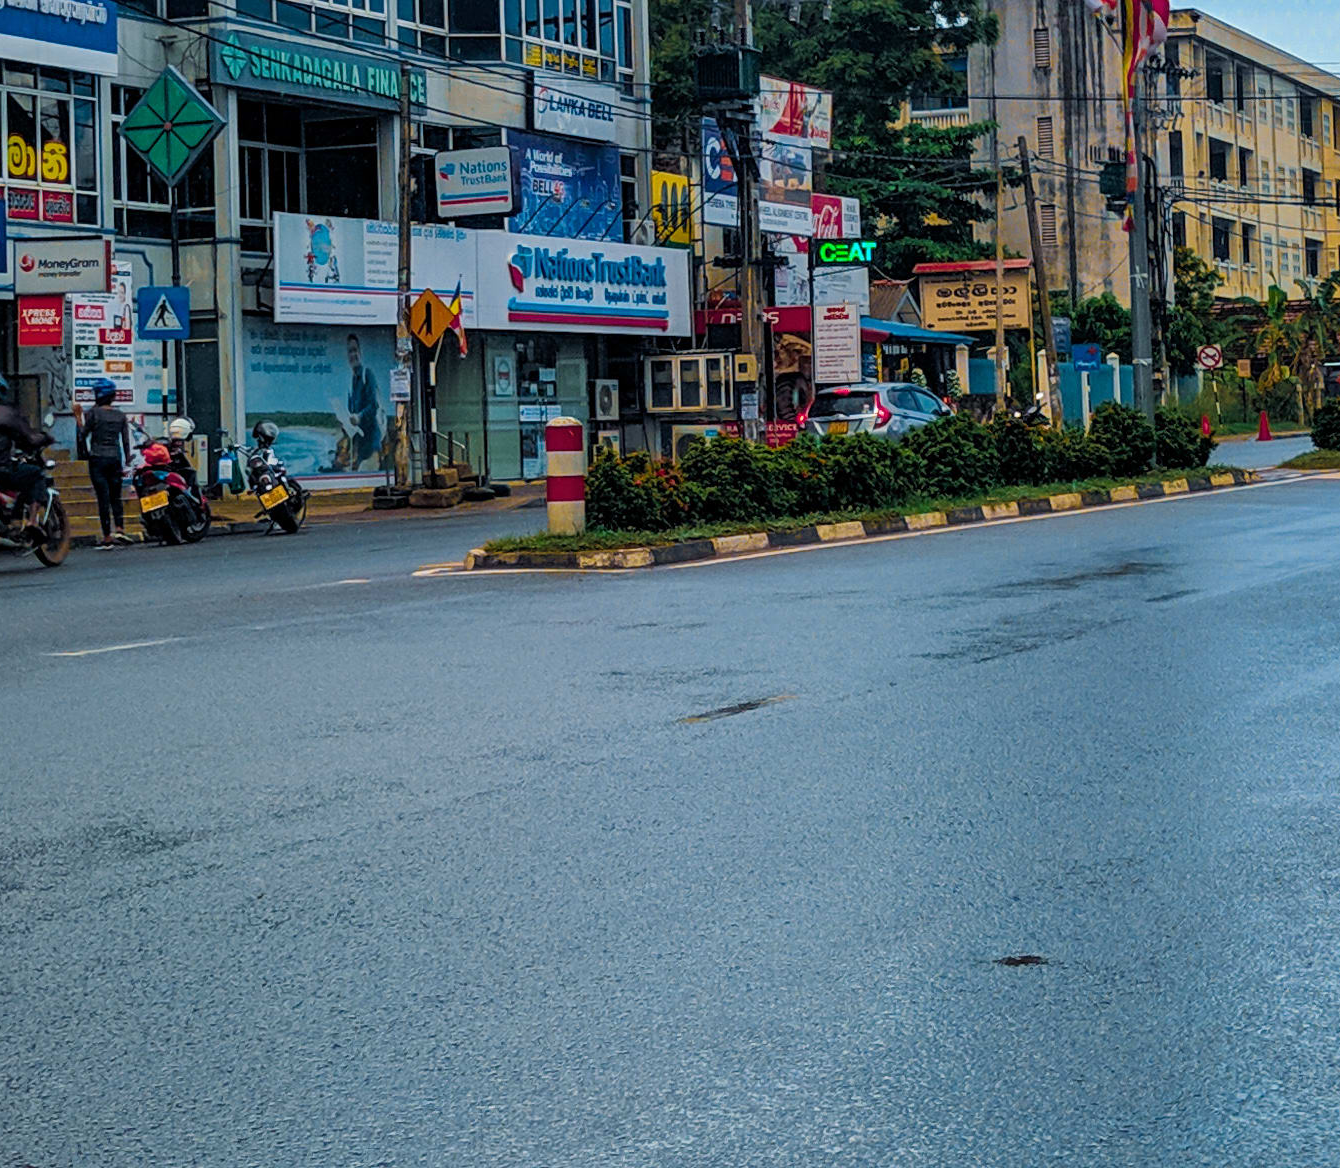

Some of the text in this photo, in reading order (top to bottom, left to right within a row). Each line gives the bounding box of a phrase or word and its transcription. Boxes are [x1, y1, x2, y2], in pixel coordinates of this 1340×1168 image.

[250, 46, 427, 103] SENKADAGALA FINACE
[549, 95, 614, 122] LANKA BELL
[532, 149, 554, 162] World
[555, 152, 563, 163] of
[459, 161, 507, 174] Nations
[819, 242, 877, 262] CEAT
[38, 258, 99, 271] MoneyGram
